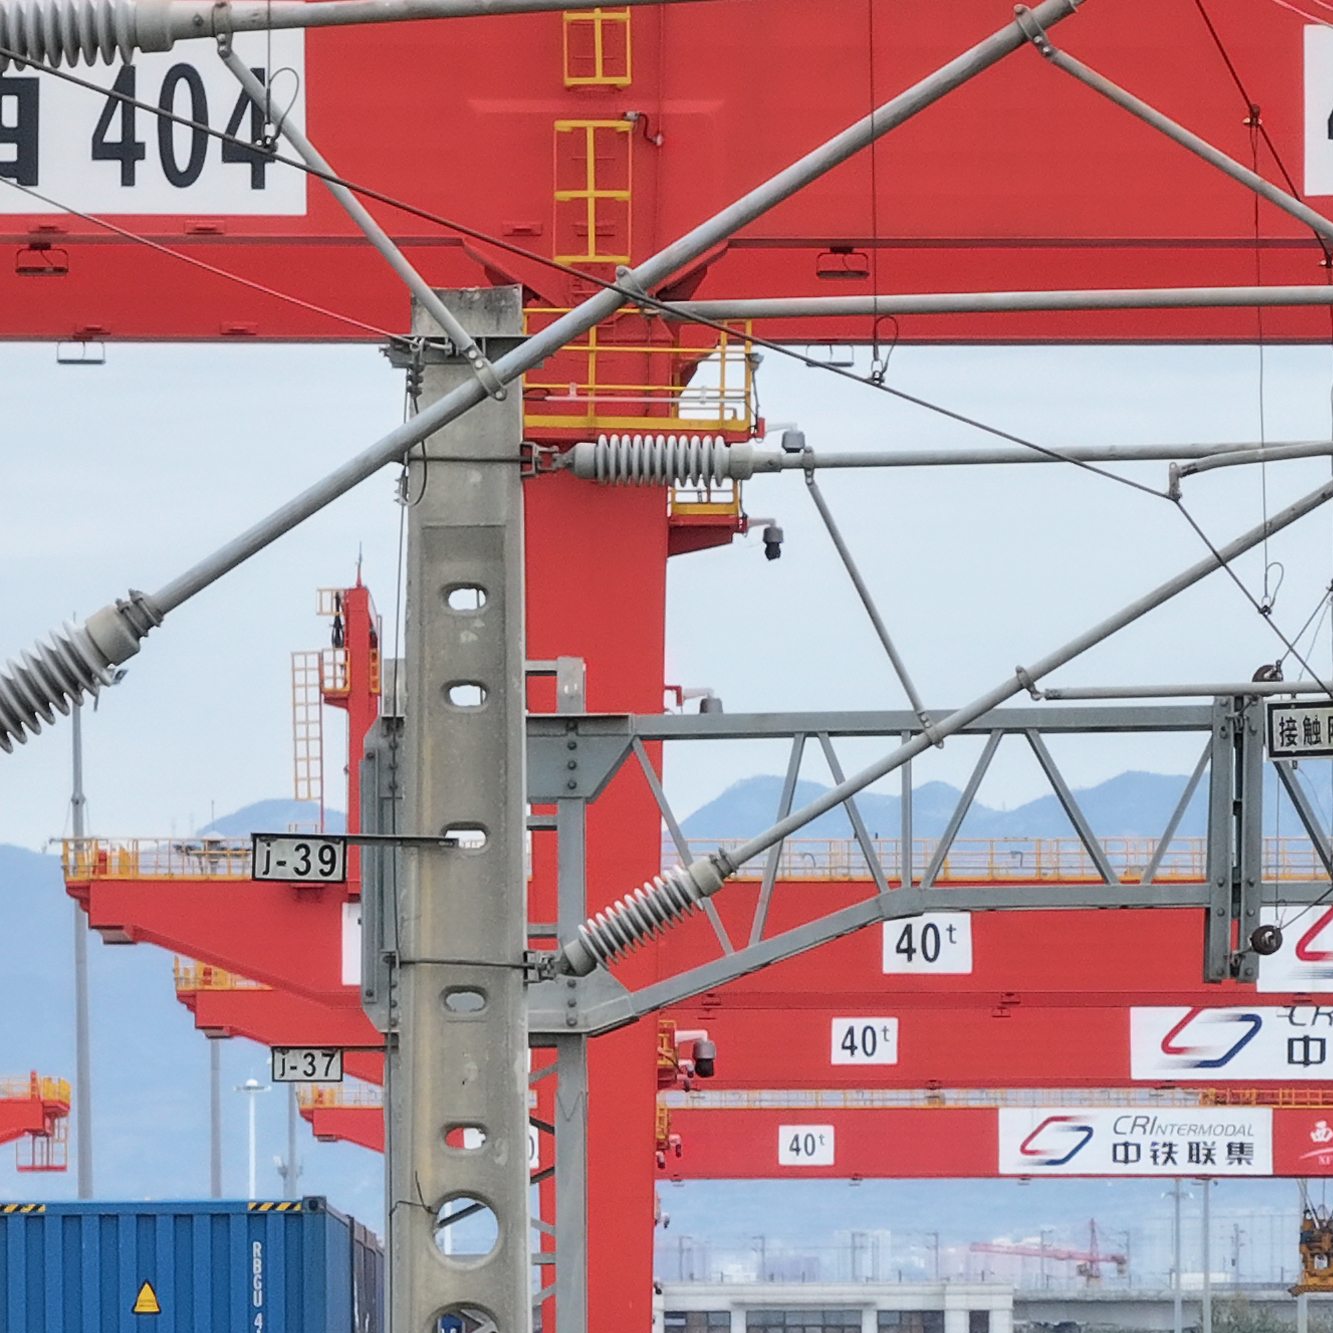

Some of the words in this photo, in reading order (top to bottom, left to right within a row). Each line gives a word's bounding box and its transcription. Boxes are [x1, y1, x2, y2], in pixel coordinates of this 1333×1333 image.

[91, 61, 276, 190] 404
[1112, 1115, 1255, 1137] CRINTERMODAL
[1112, 1140, 1255, 1166] 中铁联集
[252, 1241, 263, 1308] RBGU
